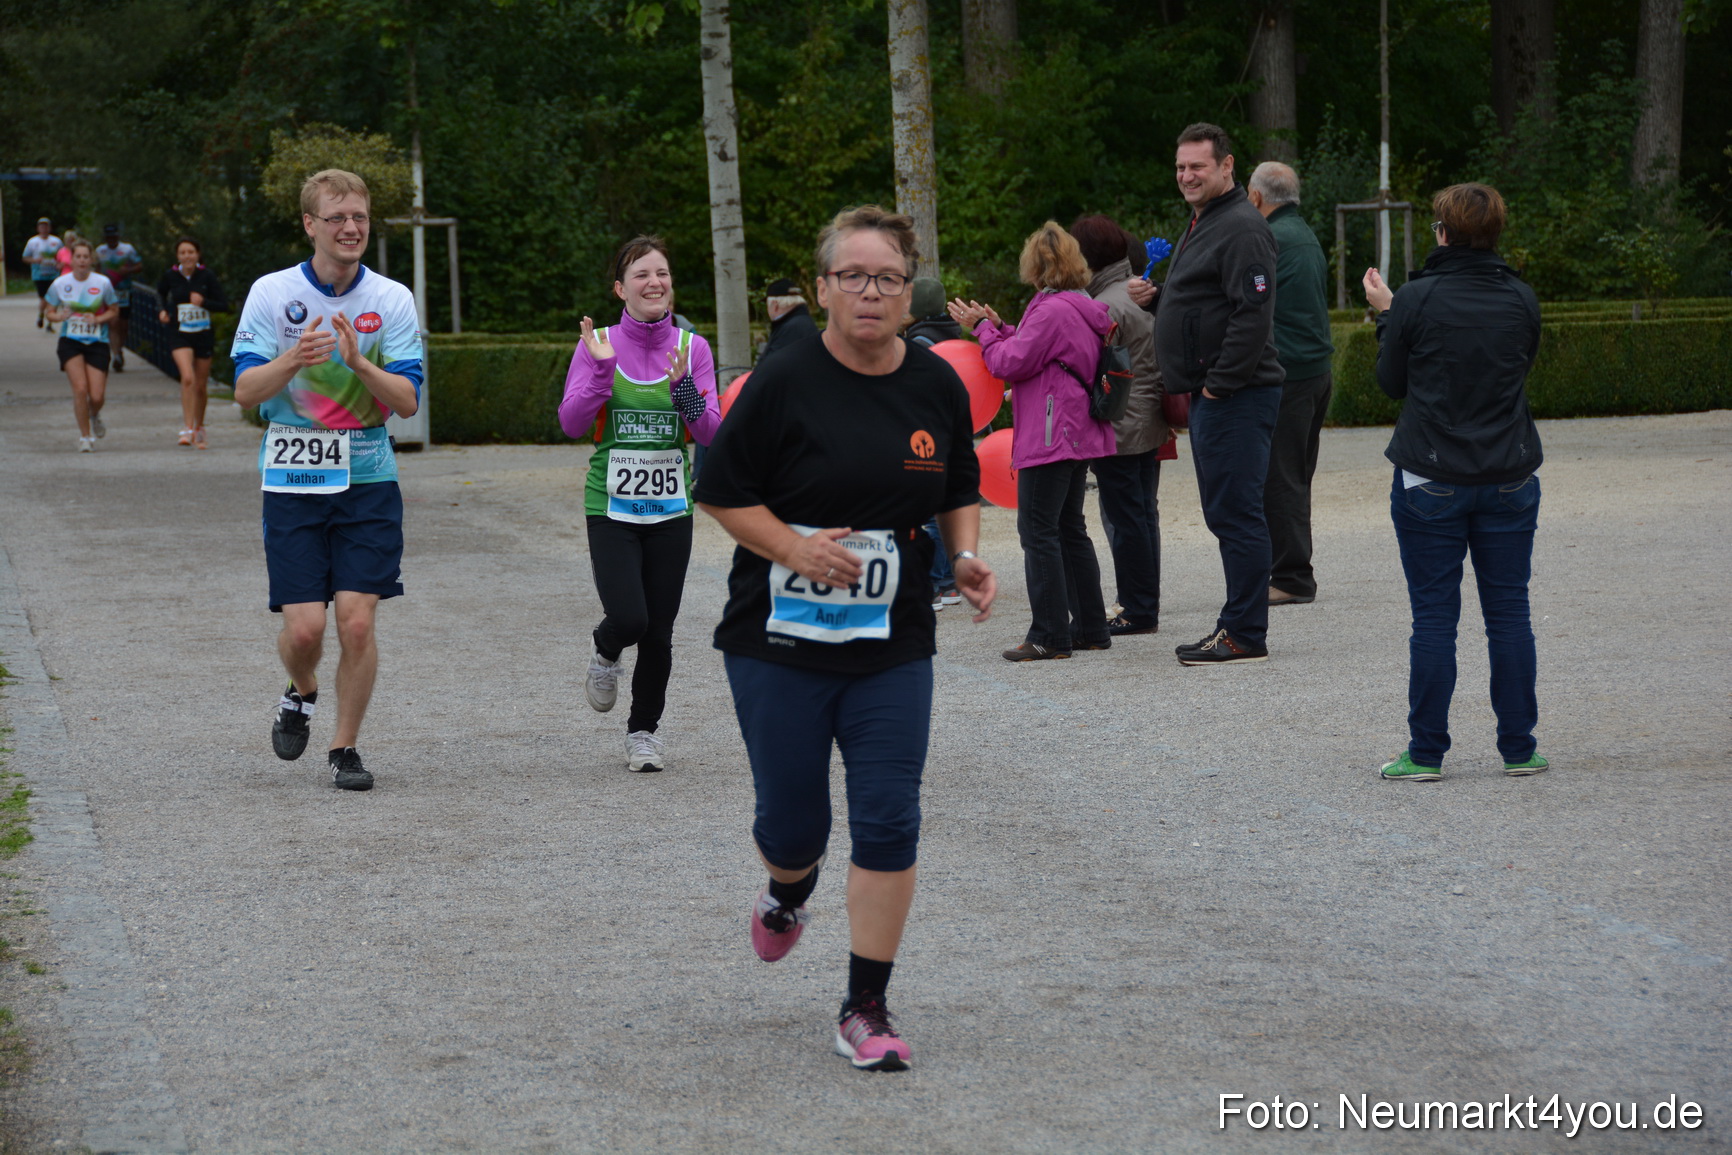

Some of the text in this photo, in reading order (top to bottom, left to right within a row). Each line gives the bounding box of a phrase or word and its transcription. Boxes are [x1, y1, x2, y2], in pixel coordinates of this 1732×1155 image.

[284, 326, 306, 335] PART
[617, 413, 673, 425] NO MEAT
[270, 426, 335, 434] PARTL Neumarkt
[618, 424, 673, 435] ATHLETE
[273, 437, 342, 466] 2294
[611, 456, 673, 465] PARTL Neumarkt
[286, 472, 326, 484] Nathan
[616, 467, 679, 496] 2295
[632, 502, 664, 514] Selina
[836, 539, 882, 551] umarkt
